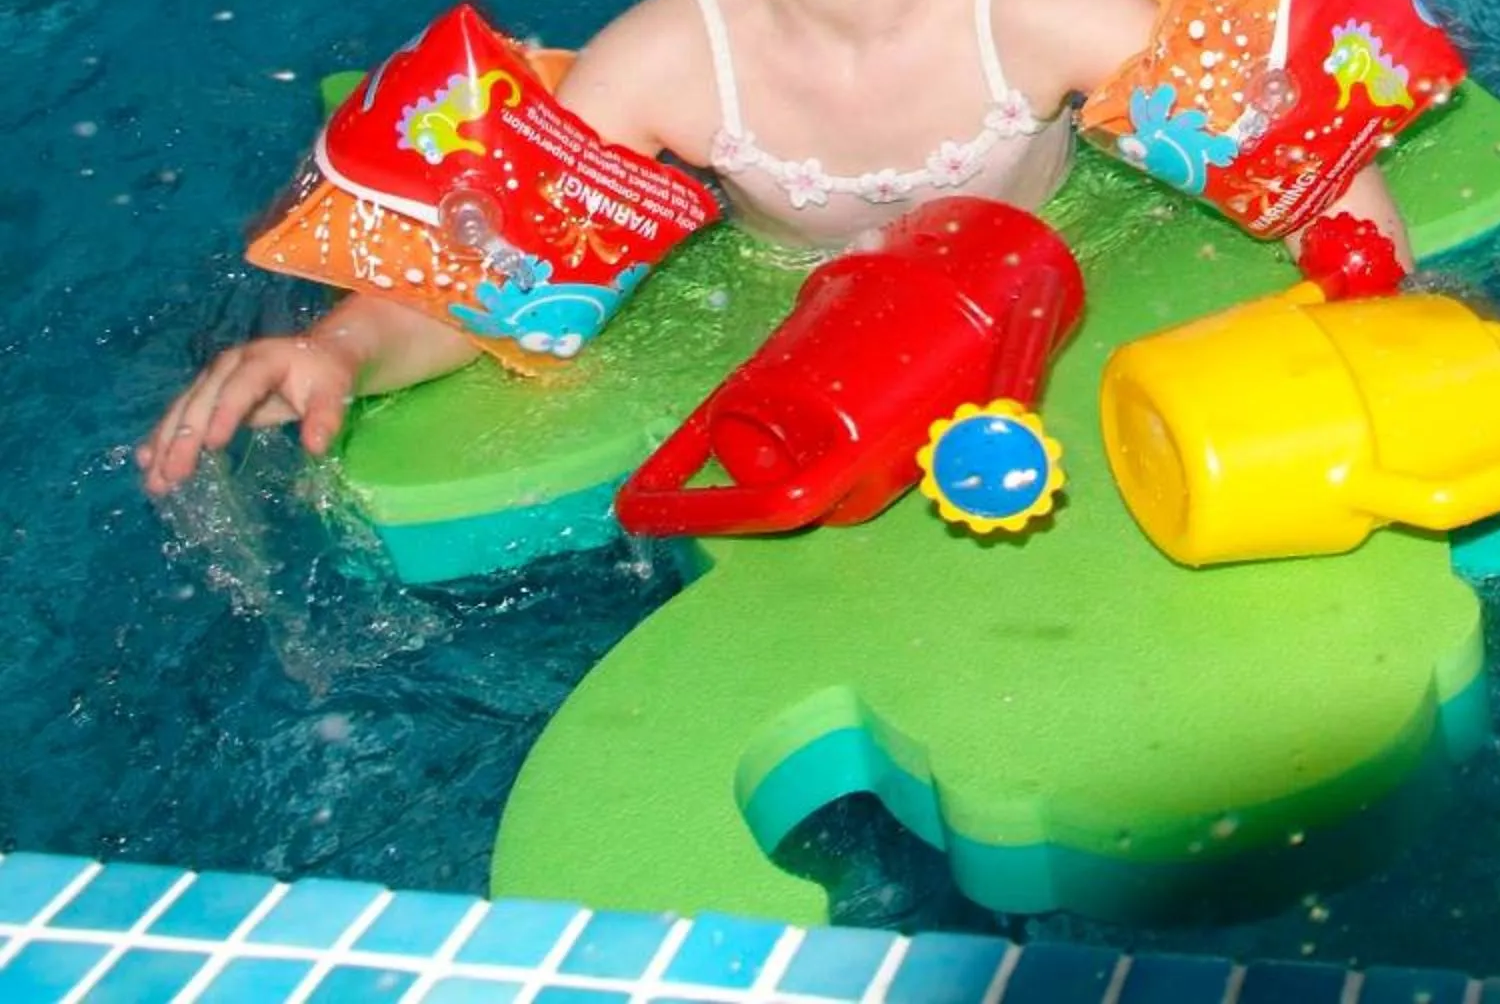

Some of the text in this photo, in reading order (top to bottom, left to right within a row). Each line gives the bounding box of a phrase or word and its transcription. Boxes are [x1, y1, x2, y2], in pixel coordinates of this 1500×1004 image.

[576, 161, 641, 202] competent
[550, 171, 658, 240] WARNNG!
[641, 198, 675, 219] under
